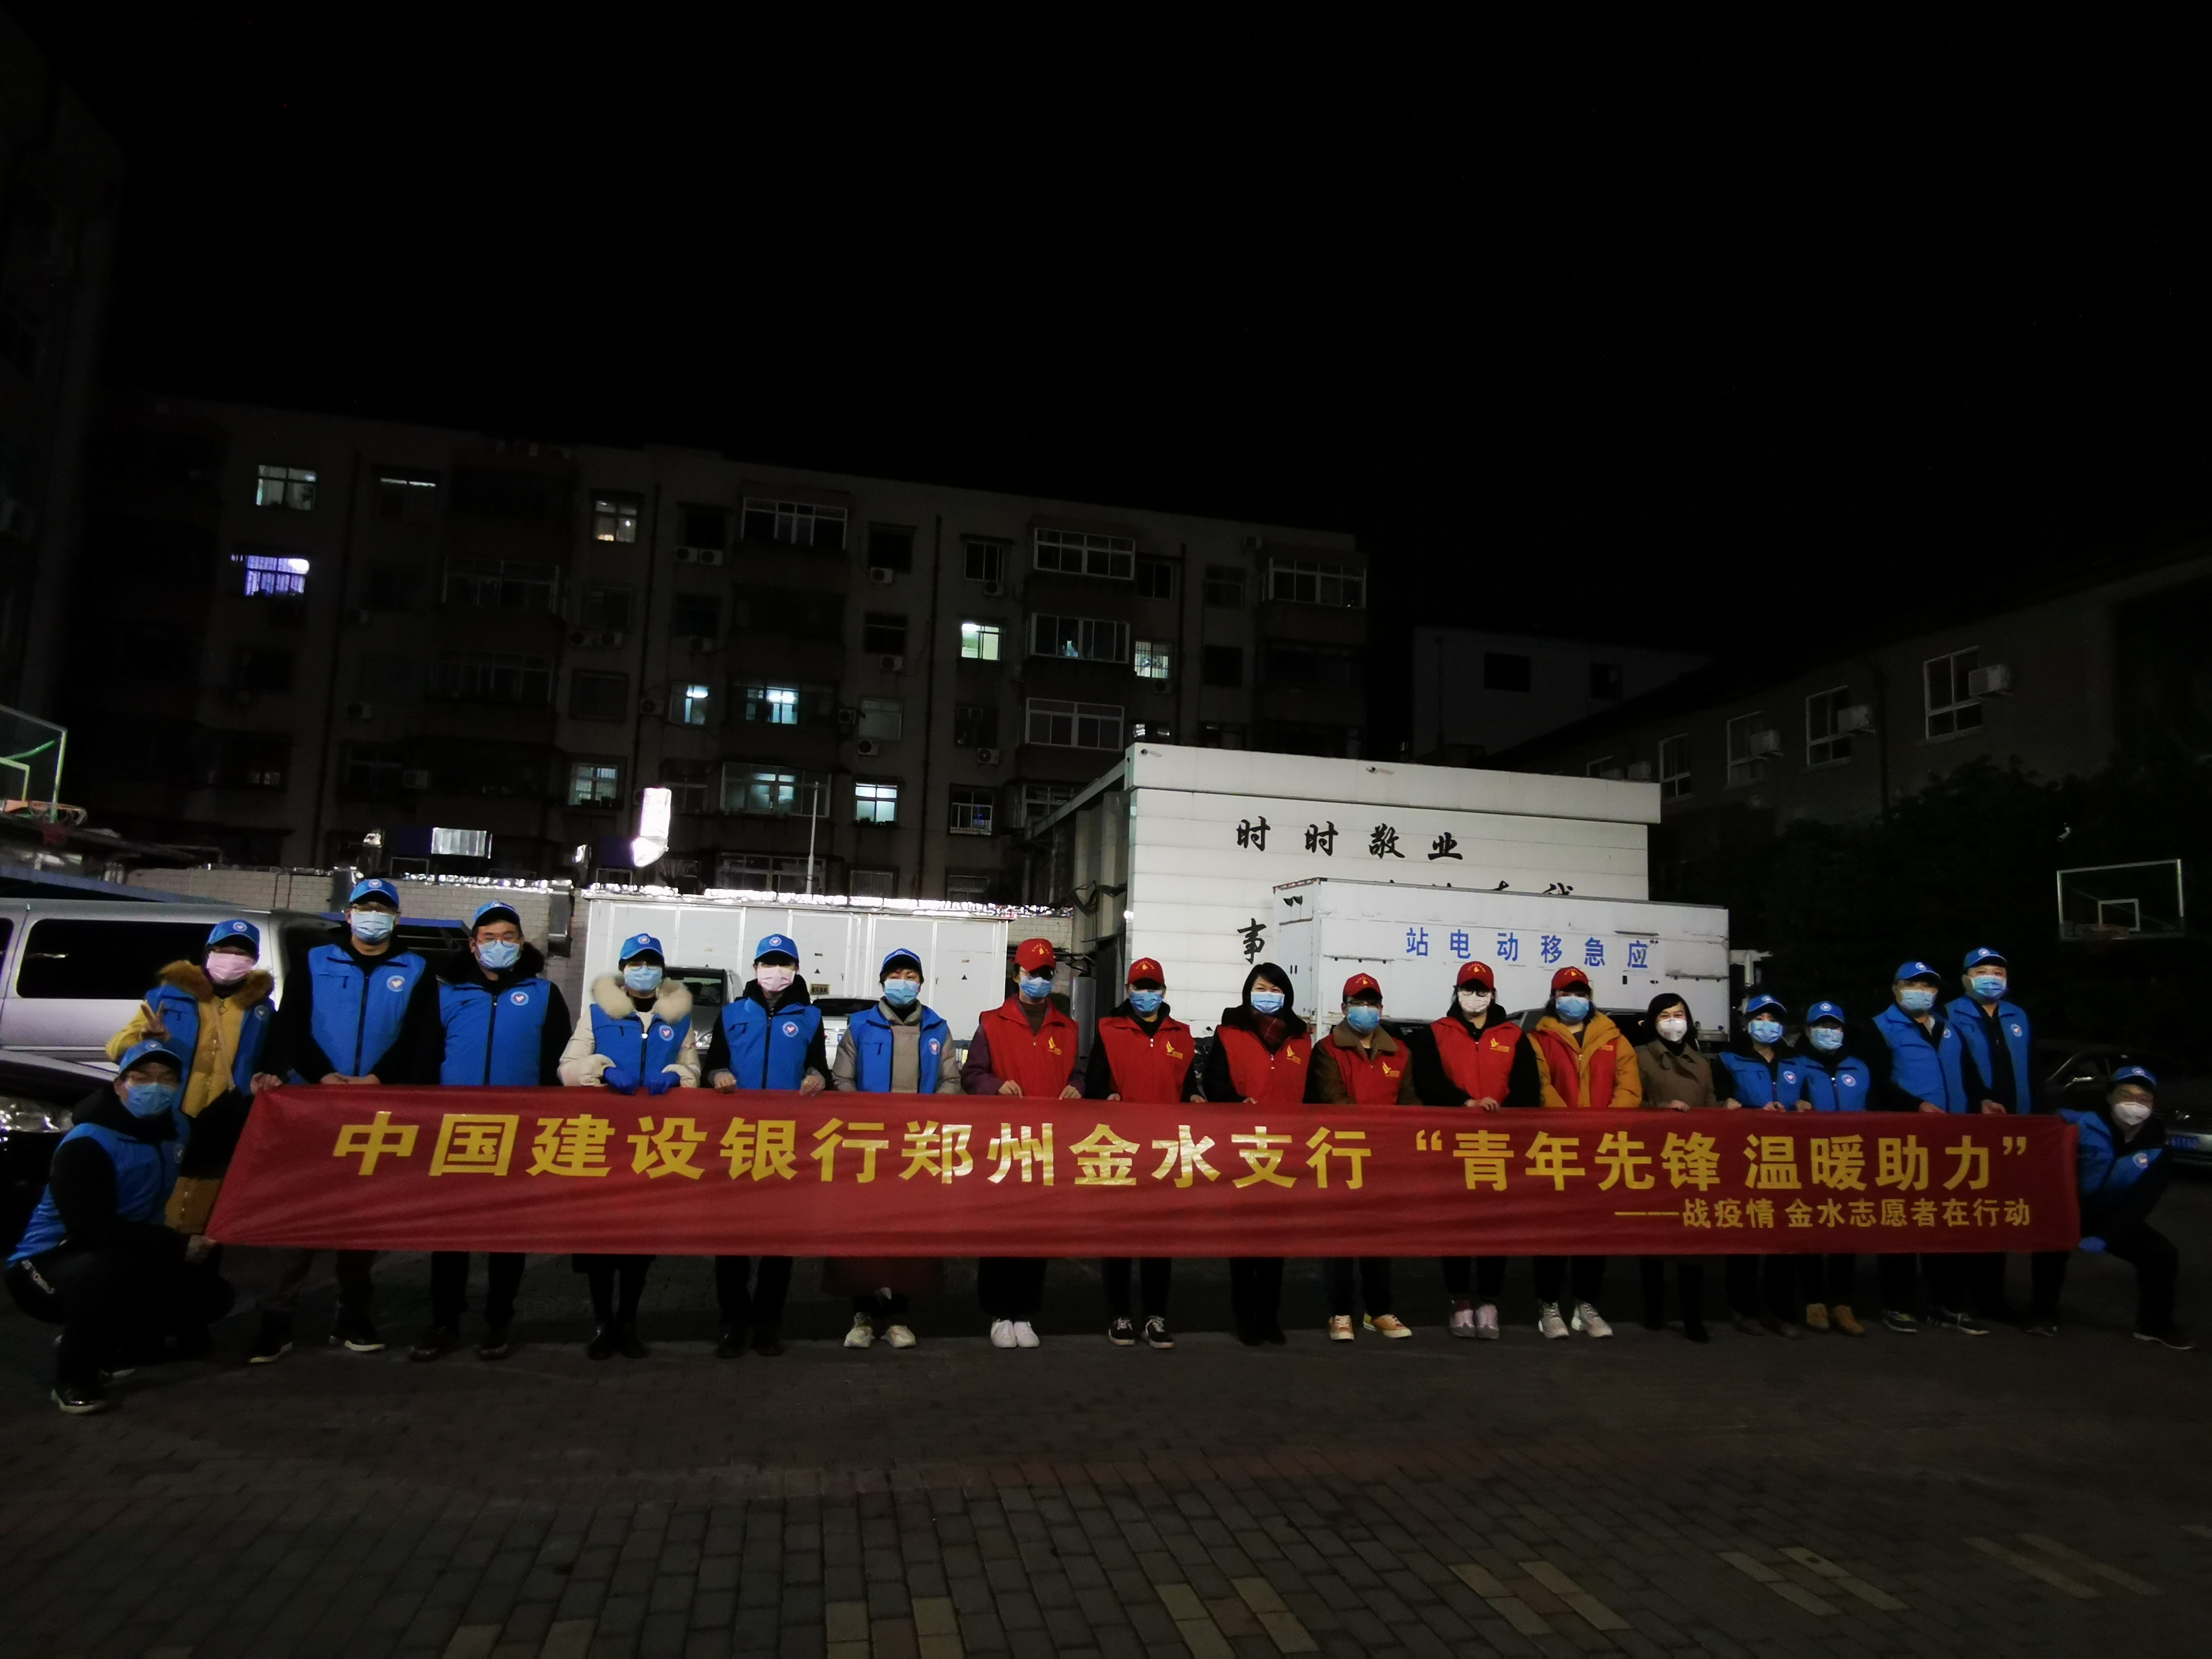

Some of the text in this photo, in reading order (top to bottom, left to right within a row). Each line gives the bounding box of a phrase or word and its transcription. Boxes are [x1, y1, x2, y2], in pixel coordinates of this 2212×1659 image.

[1236, 816, 1463, 860] 时时敬业
[1237, 918, 1267, 964] 事
[333, 1110, 1372, 1190] 中国建设银行郑州金水支行
[1784, 1198, 2031, 1228] 金水志愿者在行动
